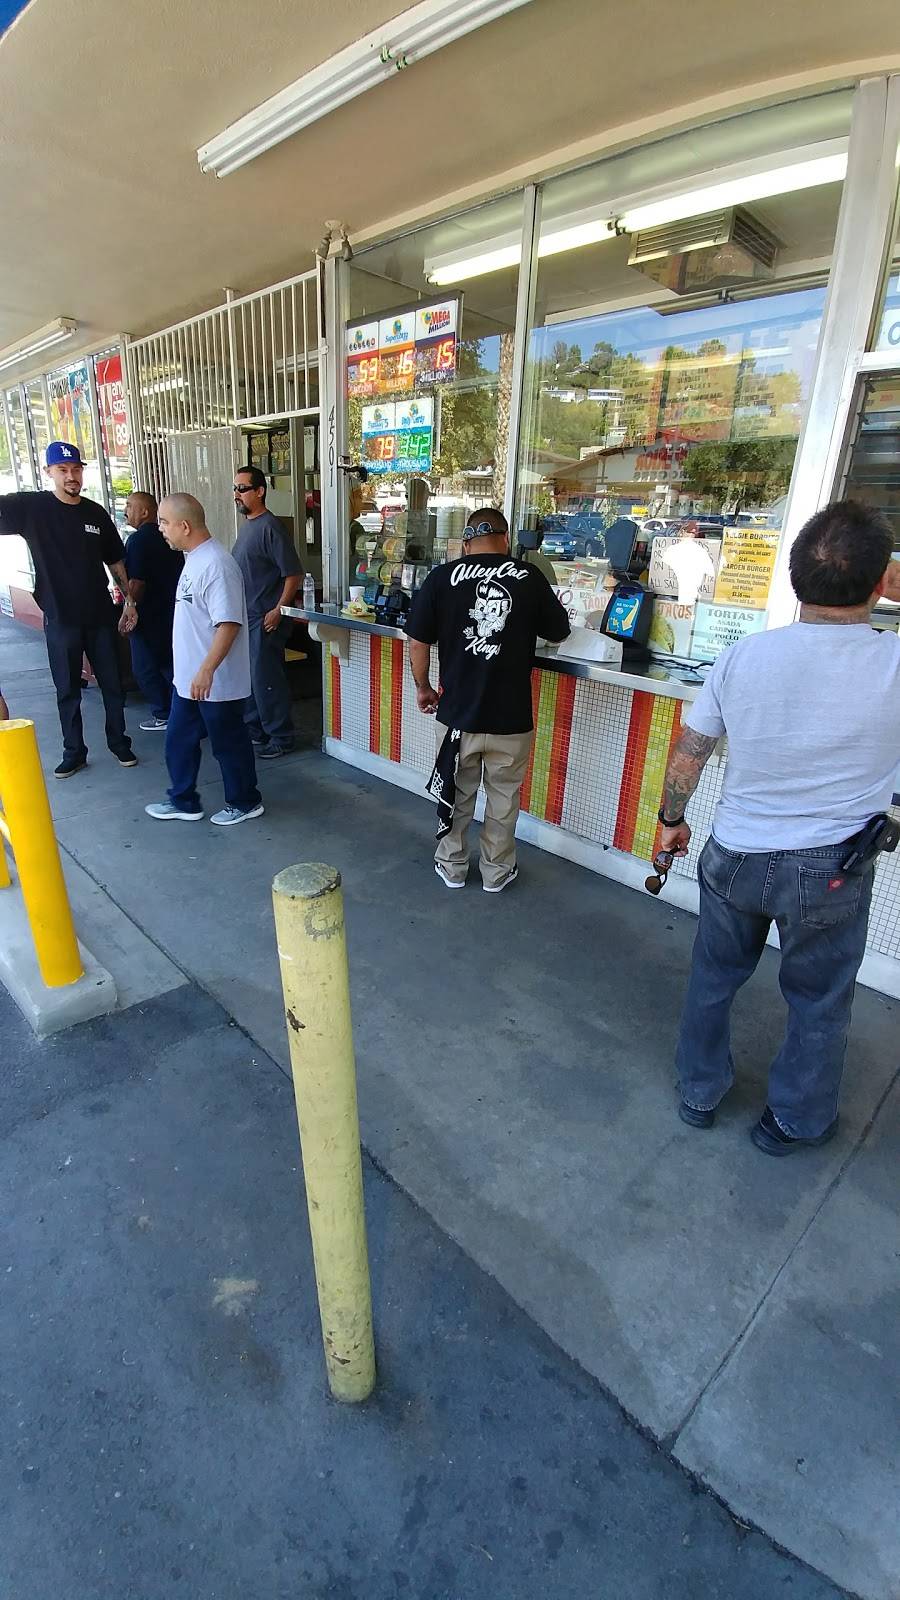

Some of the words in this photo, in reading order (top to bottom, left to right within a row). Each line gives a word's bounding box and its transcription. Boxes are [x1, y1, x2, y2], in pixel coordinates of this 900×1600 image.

[431, 310, 451, 325] MEGA
[60, 445, 73, 457] LA
[655, 538, 667, 549] NO
[656, 602, 693, 620] TACOS
[706, 608, 755, 622] TORTAS
[717, 619, 741, 628] ASADA
[714, 633, 740, 641] POLLO
